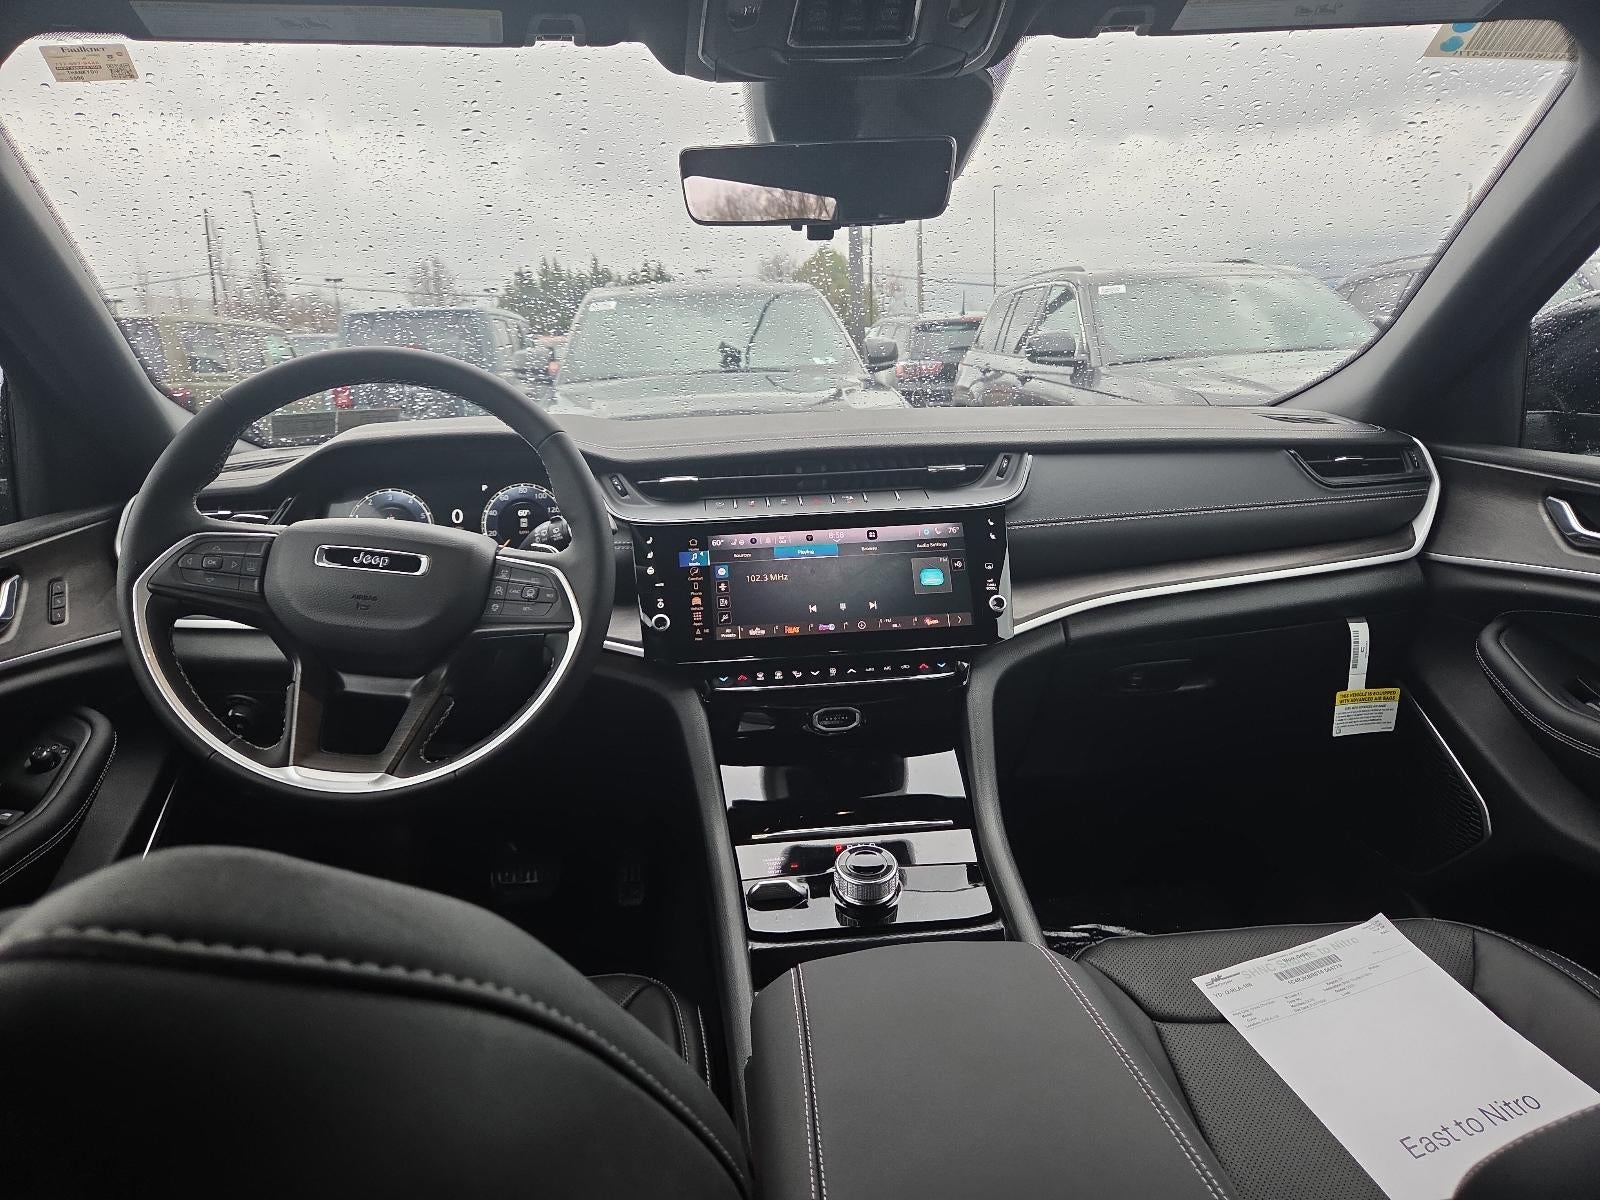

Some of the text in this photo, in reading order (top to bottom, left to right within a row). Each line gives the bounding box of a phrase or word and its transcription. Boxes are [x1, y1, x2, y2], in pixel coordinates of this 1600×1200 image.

[451, 508, 464, 524] 0
[488, 529, 498, 537] 20
[352, 551, 390, 568] Jeep
[746, 573, 789, 583] 102.3 MHz
[1330, 936, 1360, 951] Nitro
[1400, 1095, 1541, 1160] East to Nitro
